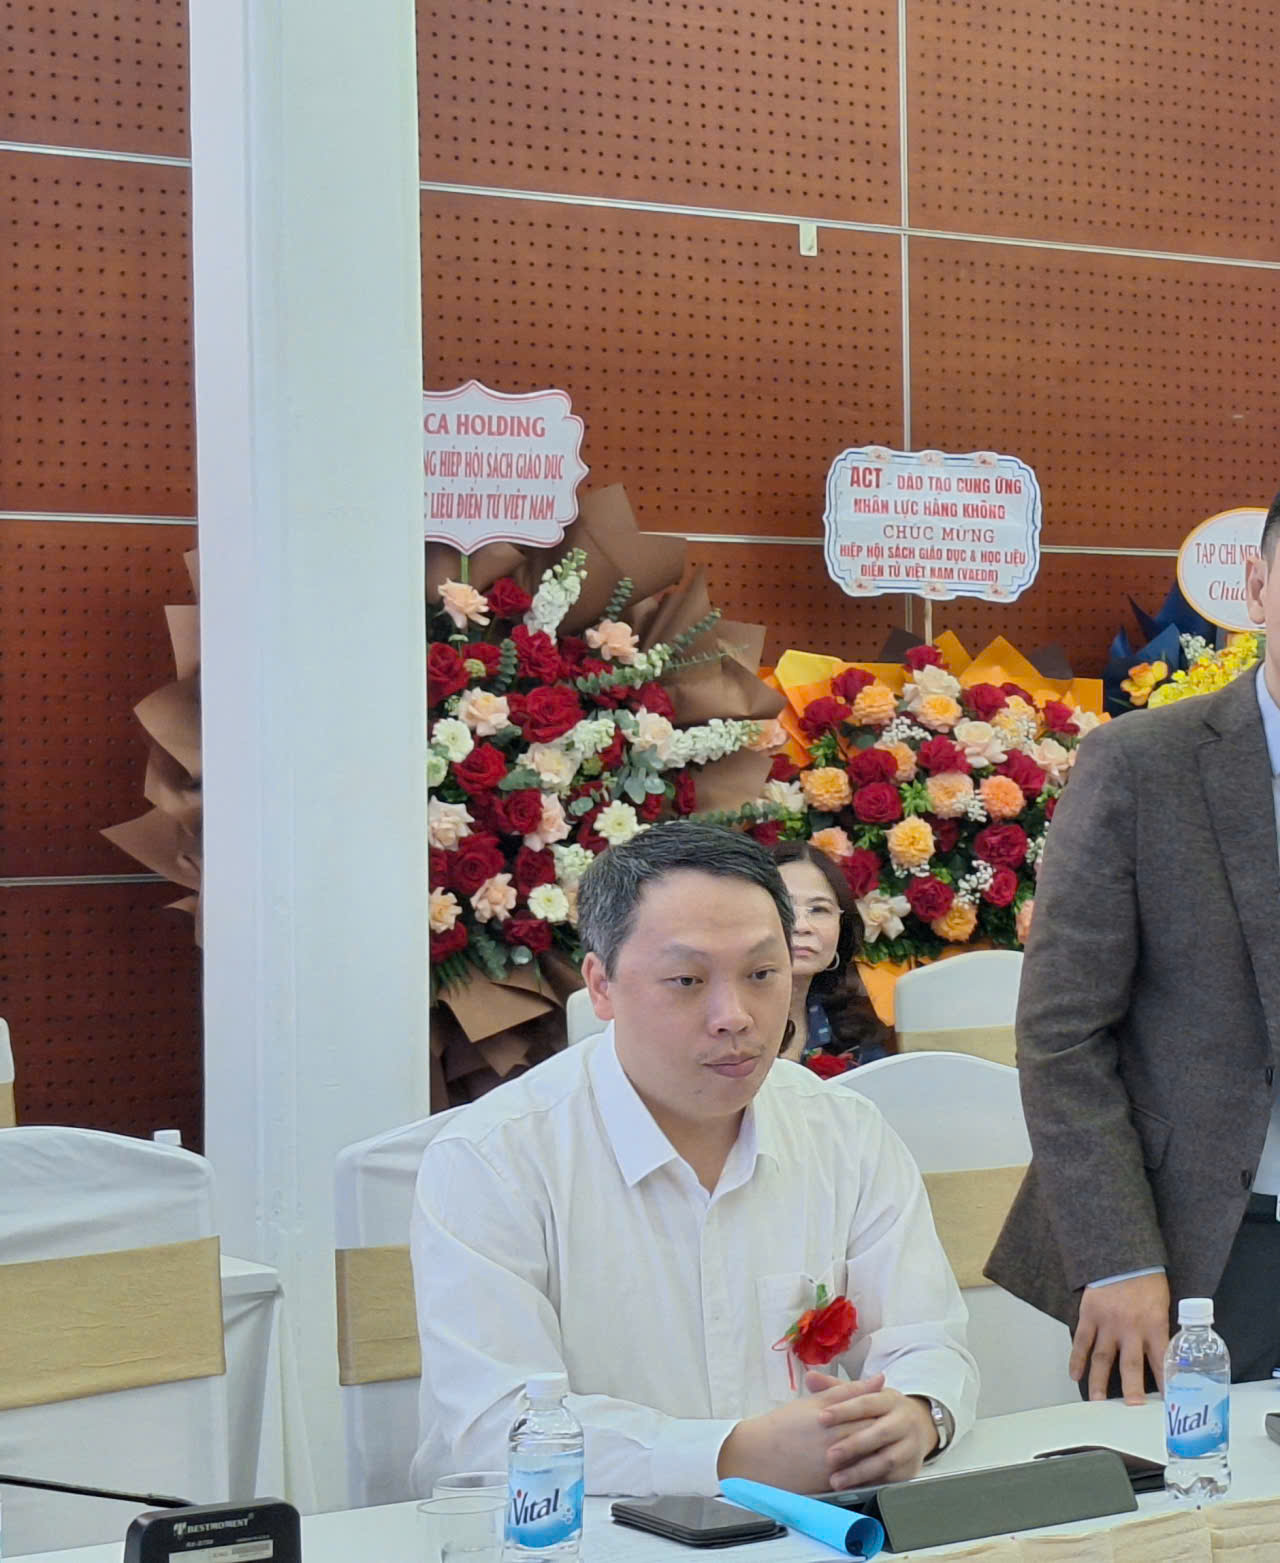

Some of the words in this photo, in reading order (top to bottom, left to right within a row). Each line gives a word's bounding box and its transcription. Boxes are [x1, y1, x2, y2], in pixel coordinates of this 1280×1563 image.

[456, 414, 546, 438] HOLDING
[439, 445, 462, 483] HIỆP
[465, 446, 484, 484] HỘI
[487, 446, 513, 479] SÁCH
[516, 447, 541, 480] GIÁO
[850, 466, 883, 489] ACT
[928, 476, 951, 495] TẠO
[957, 477, 990, 494] CUNG
[995, 475, 1022, 495] ỨNG
[430, 486, 455, 525] LIỆU
[503, 488, 528, 525] VIỆT
[528, 494, 556, 521] NAM
[853, 494, 889, 514] NHÂN
[894, 498, 919, 518] LỰC
[923, 497, 958, 518] HÀNG
[962, 500, 1006, 520] KHÔNG
[883, 523, 934, 541] CHÚC
[941, 525, 995, 544] MỪNG
[840, 541, 863, 560] HIỆP
[867, 542, 884, 561] HỘI
[888, 543, 915, 560] SÁCH
[919, 545, 943, 561] GIÁO
[946, 547, 967, 564] DỤC
[970, 549, 976, 562] &
[980, 550, 1001, 566] HỌC
[1005, 548, 1026, 567] LIỆU
[1195, 542, 1216, 569] TẠP
[904, 562, 926, 581] VIỆT
[930, 566, 954, 580] NAM
[1168, 1404, 1209, 1437] Vital
[513, 1488, 560, 1526] Vital
